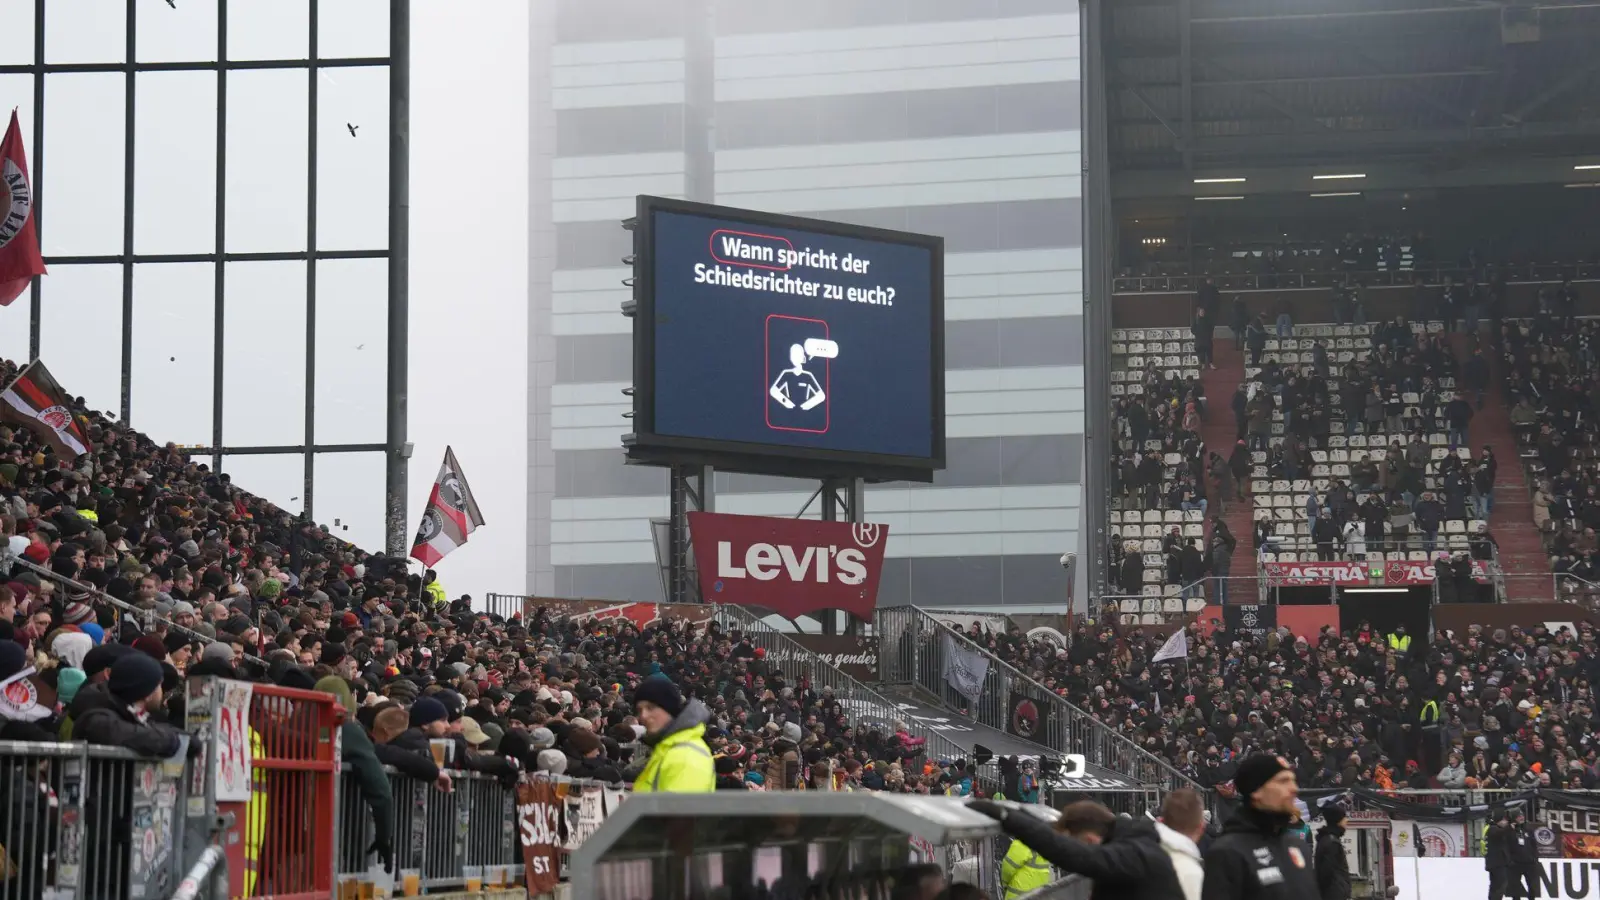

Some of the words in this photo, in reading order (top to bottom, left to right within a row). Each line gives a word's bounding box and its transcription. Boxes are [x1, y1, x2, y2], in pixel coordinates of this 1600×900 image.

[722, 236, 773, 262] Wann
[777, 246, 838, 270] spricht
[841, 253, 870, 275] der
[694, 263, 820, 297] Schiedsrichter
[823, 283, 843, 300] zu
[847, 286, 896, 306] euch?
[1287, 566, 1366, 581] ASTRA
[1407, 566, 1487, 581] ASA
[834, 651, 878, 670] gender
[532, 855, 550, 875] ST
